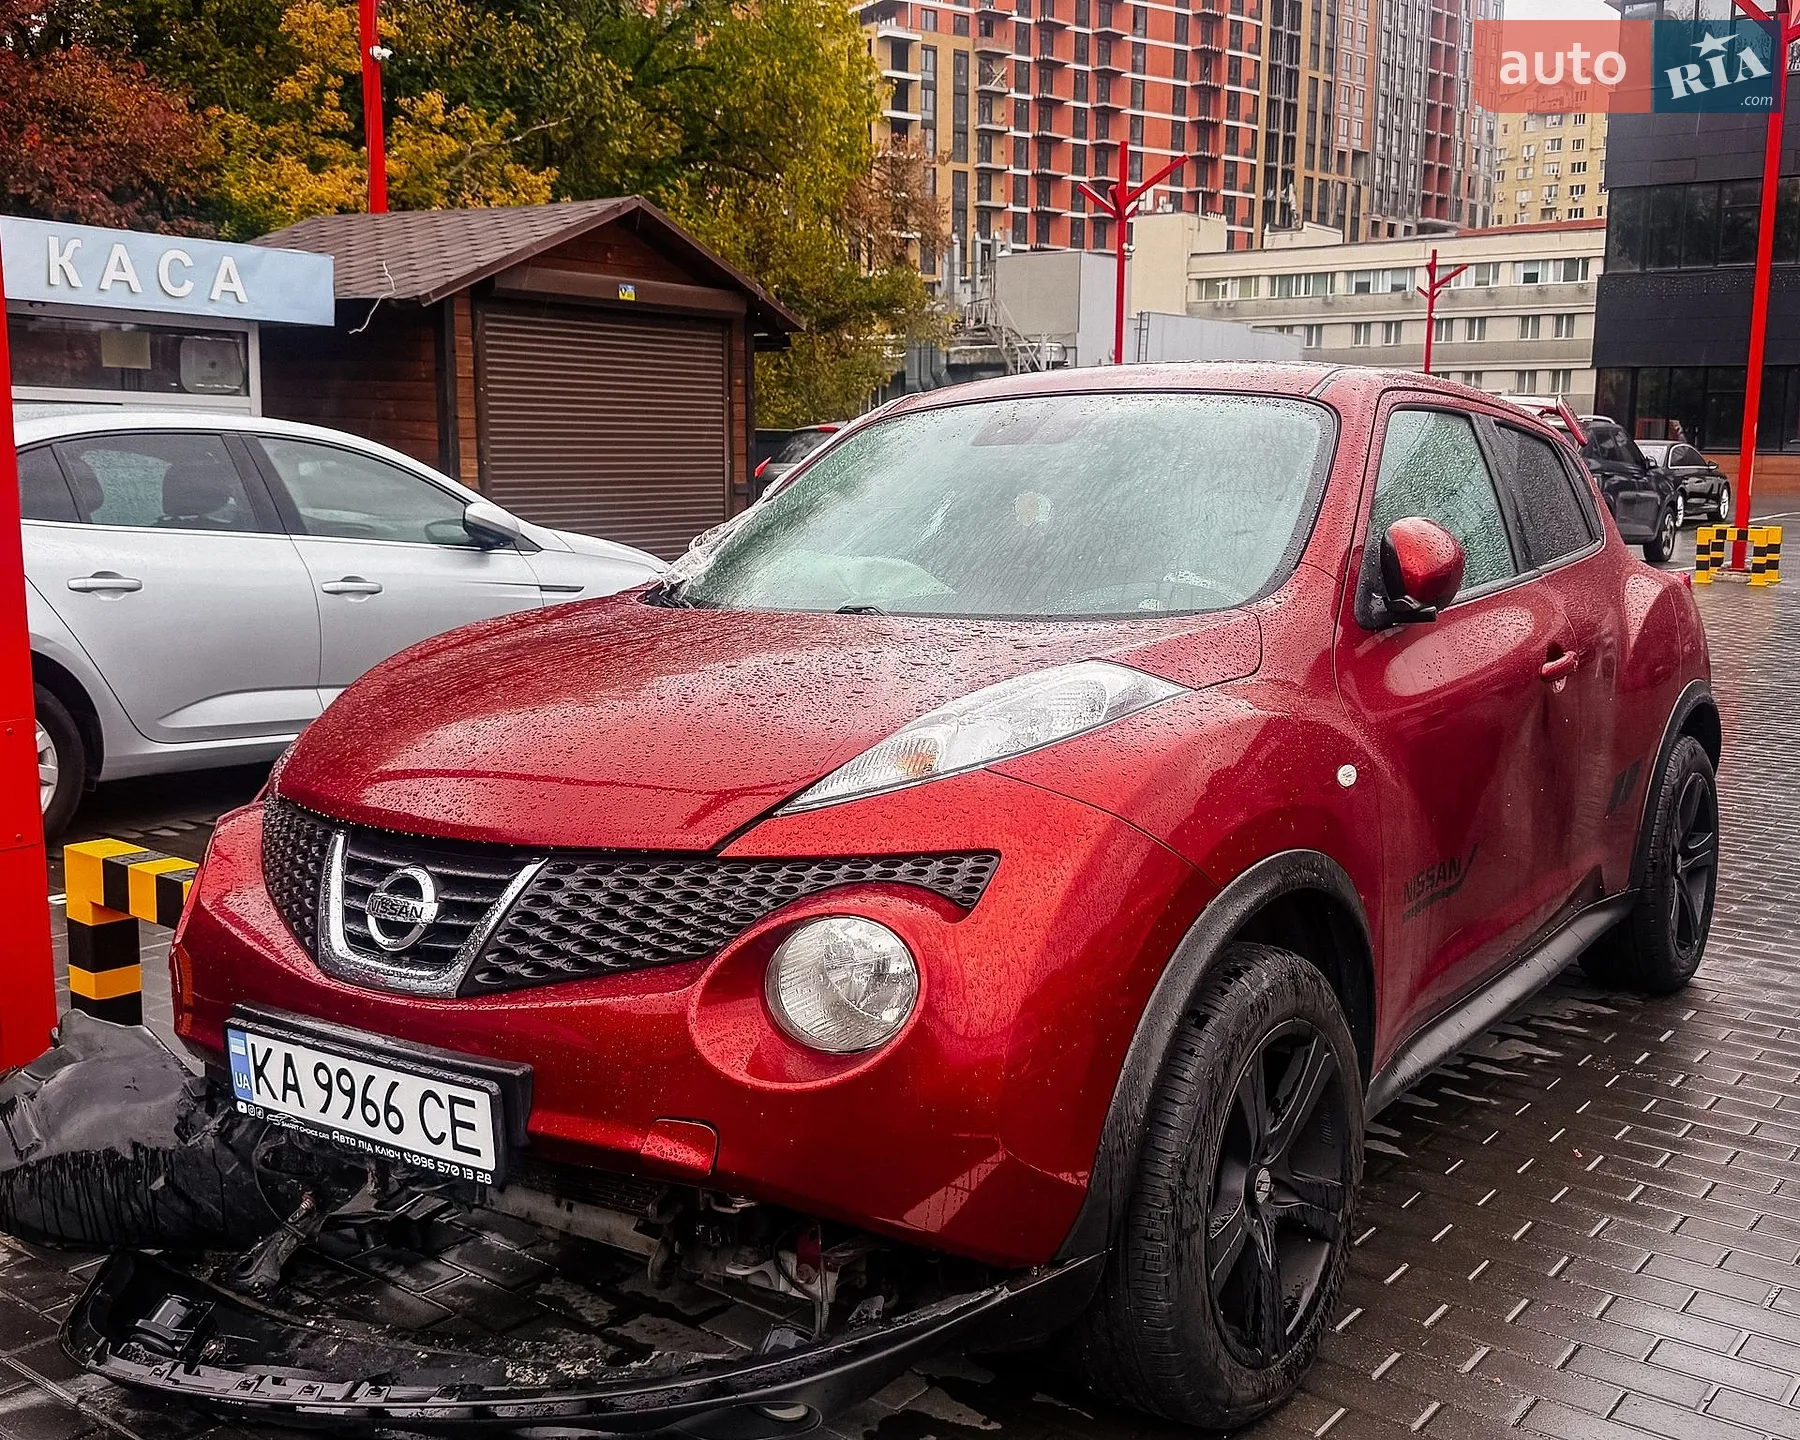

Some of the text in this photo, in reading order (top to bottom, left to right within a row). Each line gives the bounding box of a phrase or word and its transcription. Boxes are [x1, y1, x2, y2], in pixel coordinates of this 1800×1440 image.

[48, 235, 248, 303] КАСА
[1404, 857, 1461, 904] NISSAN
[369, 897, 425, 919] NISSAN
[235, 1071, 251, 1091] UA
[250, 1042, 482, 1158] KA 9966 CE
[412, 1154, 435, 1170] 096
[437, 1161, 460, 1177] 570
[462, 1167, 474, 1180] 13
[476, 1171, 492, 1185] 28
